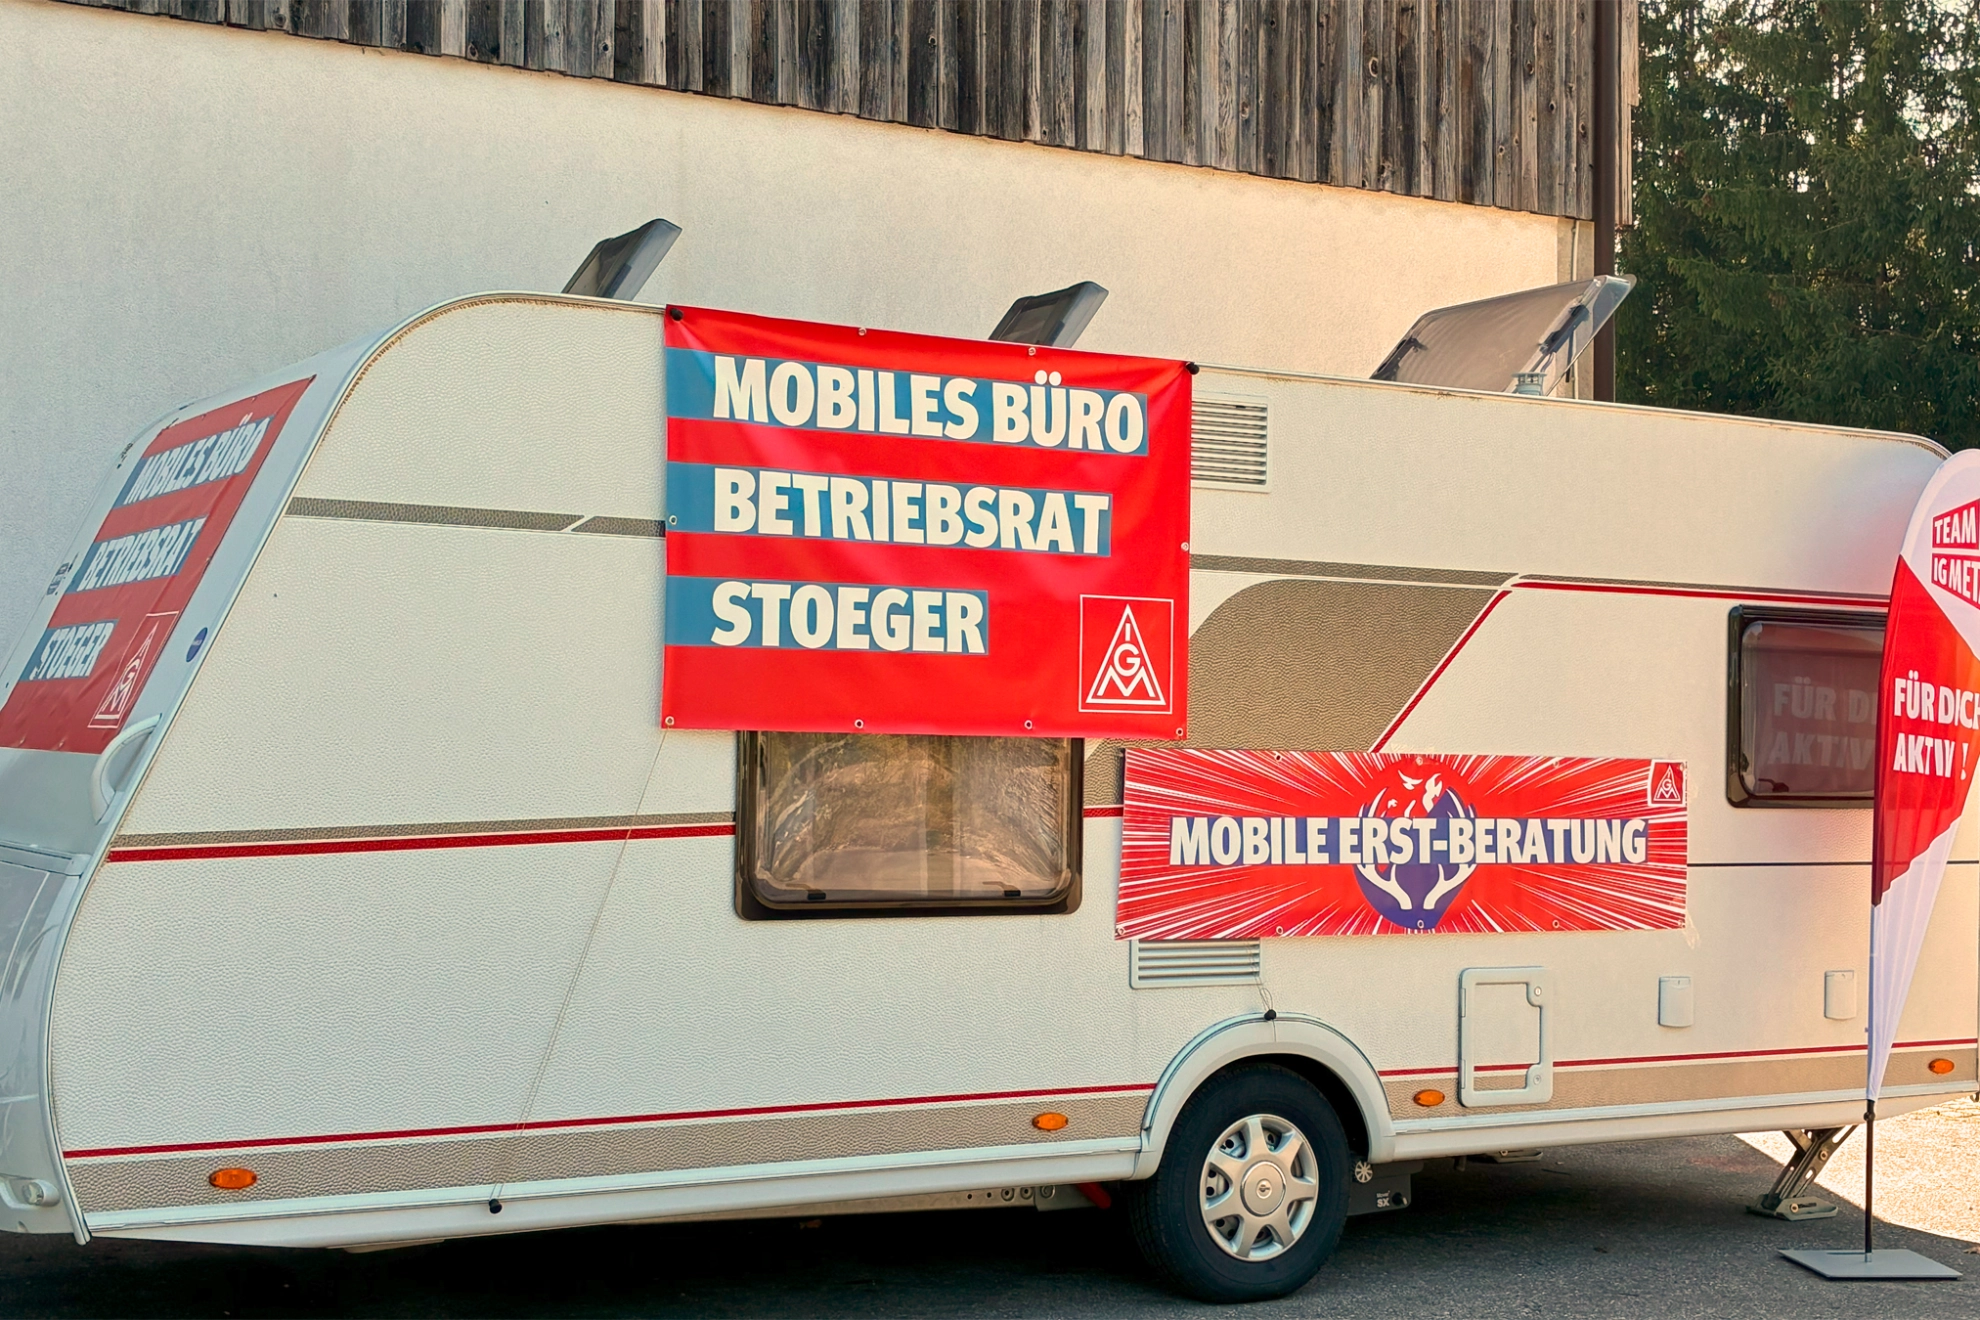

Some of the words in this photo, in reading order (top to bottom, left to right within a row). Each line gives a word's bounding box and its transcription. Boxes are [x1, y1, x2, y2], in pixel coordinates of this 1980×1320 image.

[713, 355, 980, 440] MOBILES
[992, 369, 1144, 454] BÜRO
[123, 434, 218, 506] MOBILES
[194, 411, 271, 487] BÜRO
[713, 467, 1110, 555] BETRIEBSRAT
[1934, 506, 1977, 545] TEAM
[76, 516, 208, 593] BETRIEBSRAT
[1933, 557, 1948, 586] IG
[1948, 558, 1980, 605] MET
[710, 580, 986, 655] STOEGER
[28, 621, 116, 682] STOEGER
[1773, 675, 1837, 722] FÜR
[1893, 669, 1935, 723] FÜR
[1766, 730, 1877, 771] AKTIV
[1892, 731, 1956, 779] AKTIV
[1169, 816, 1330, 866] MOBILE
[1339, 816, 1647, 865] ERST-BERATUNG
[1377, 1198, 1390, 1207] SX
